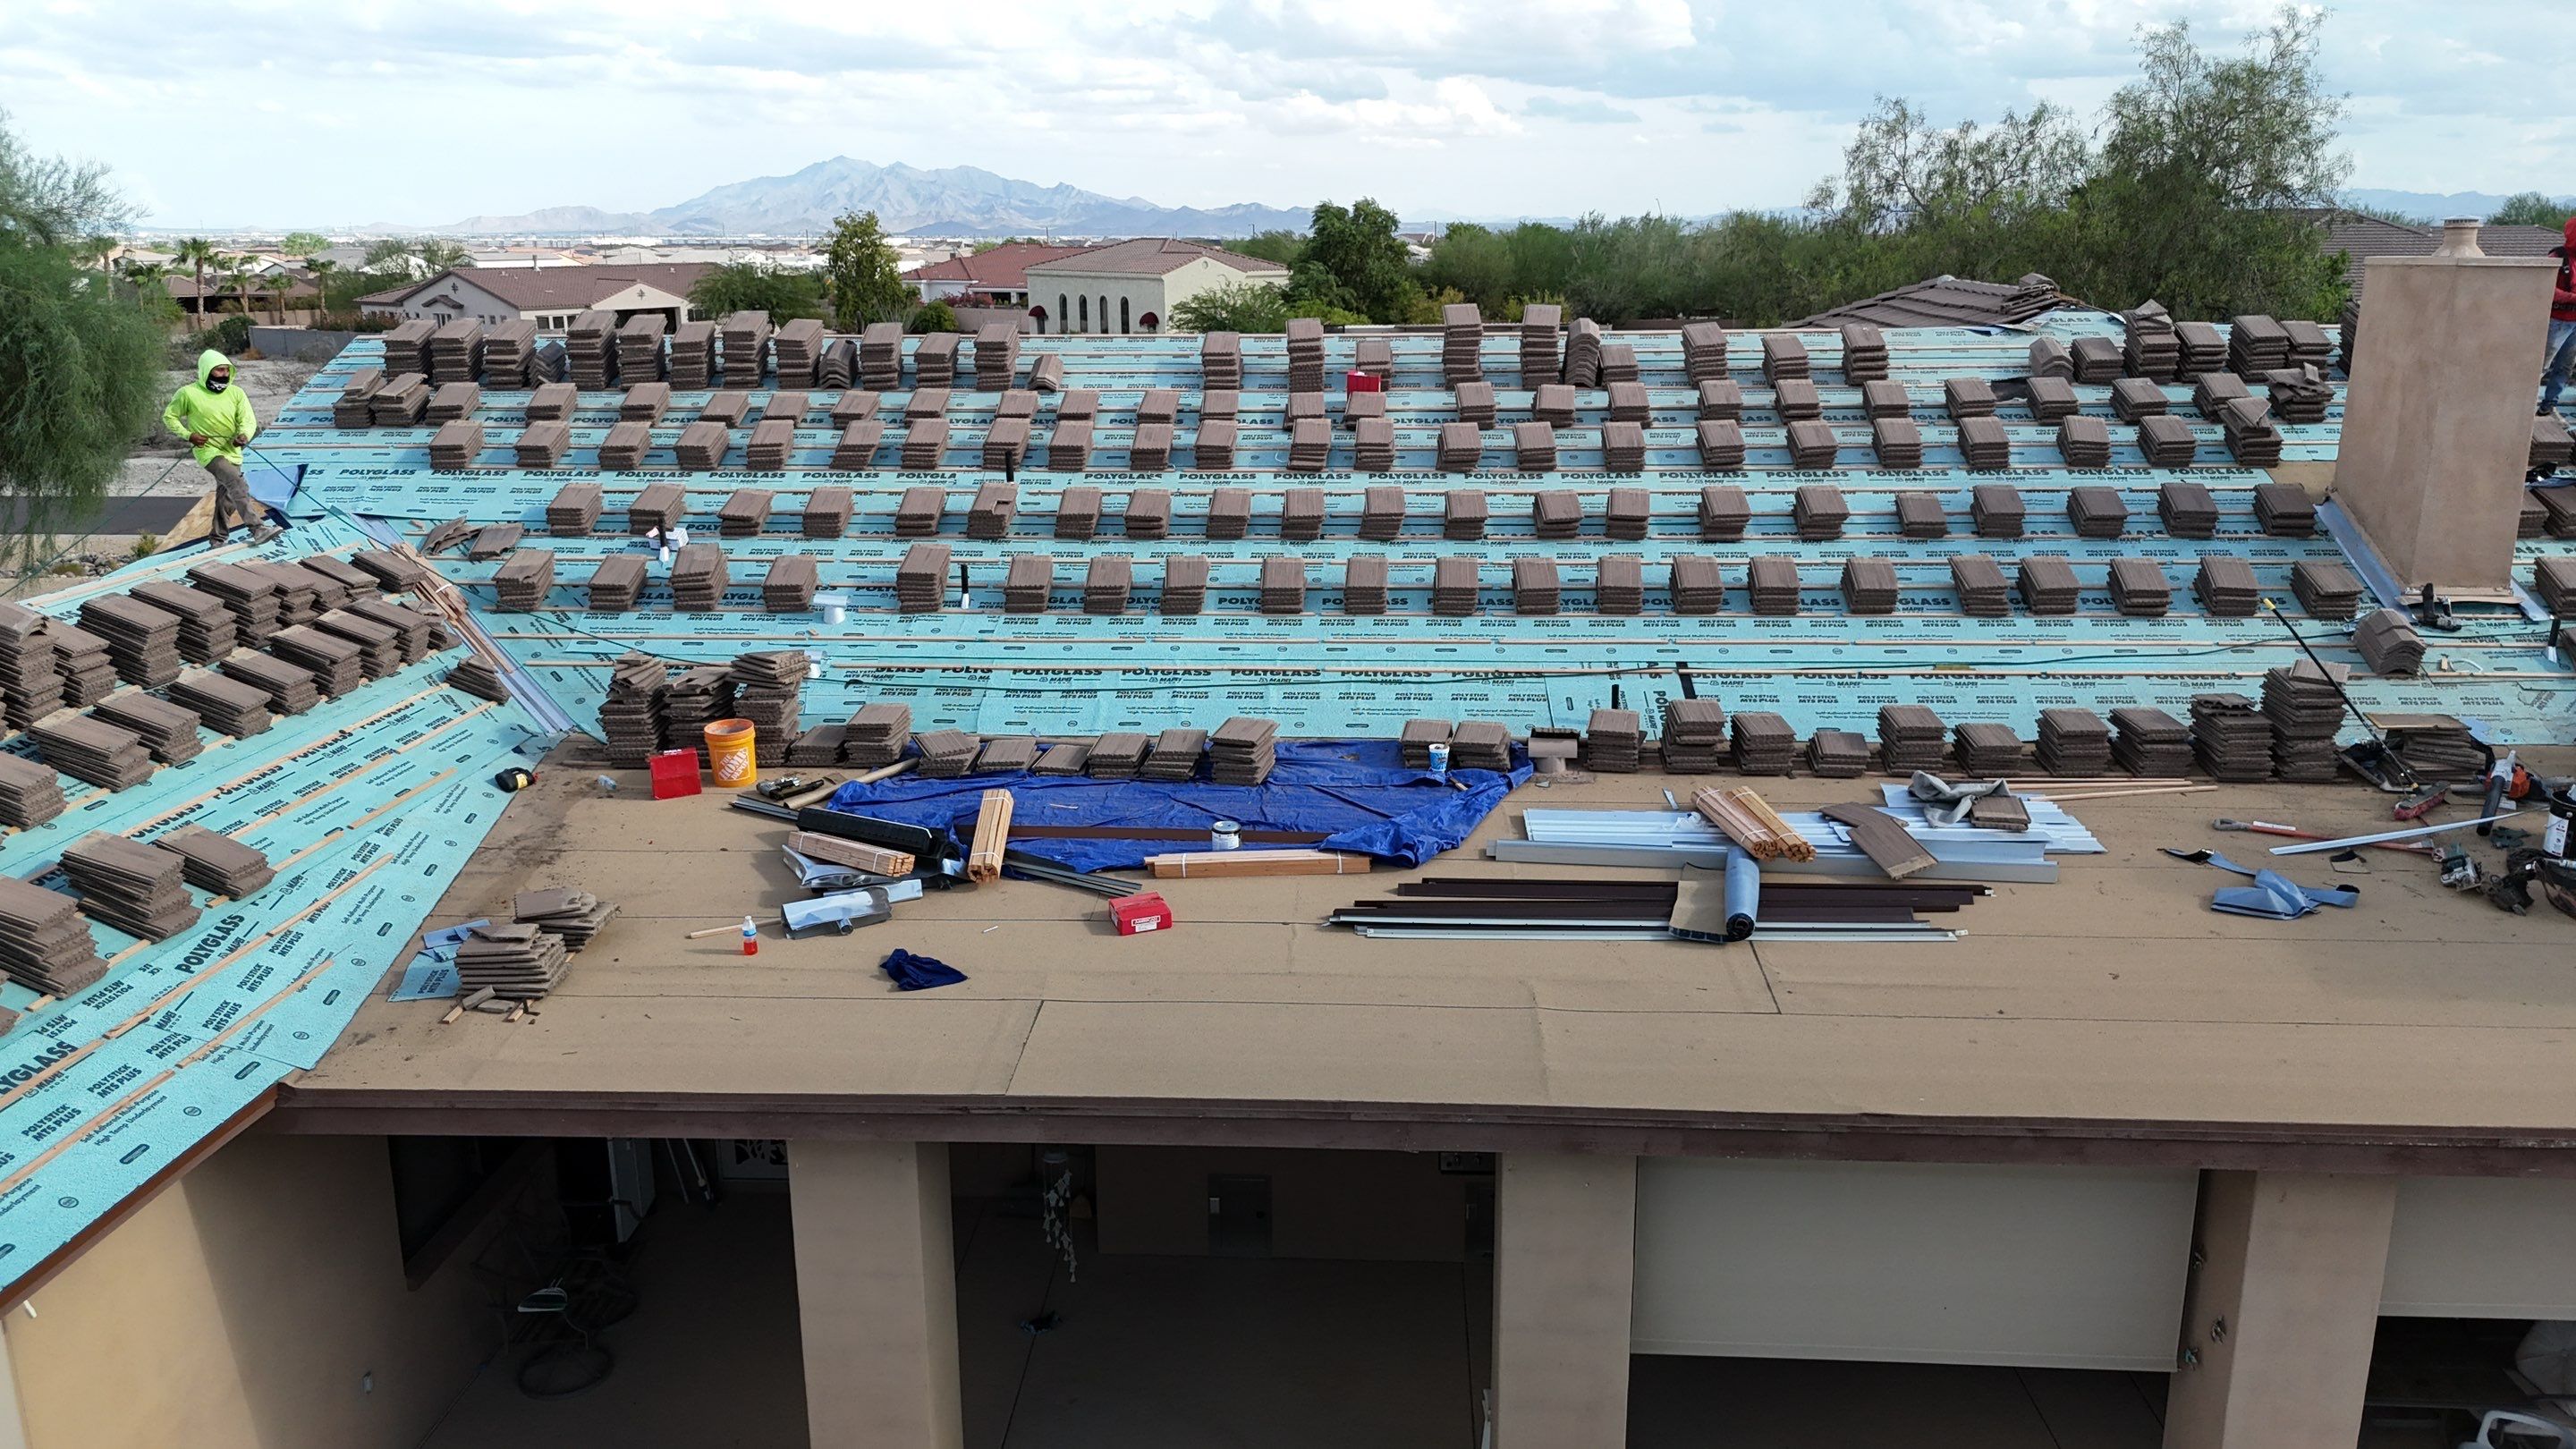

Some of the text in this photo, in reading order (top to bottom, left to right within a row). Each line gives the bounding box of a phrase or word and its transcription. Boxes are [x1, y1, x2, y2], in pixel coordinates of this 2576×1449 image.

[1767, 470, 1849, 479] POLYGLASS
[2067, 468, 2150, 476] POLYGLASS
[1230, 669, 1322, 677] POLYGLASS
[331, 744, 348, 756] MAPEI
[719, 748, 748, 780] HOME
[731, 759, 749, 780] DEPOT
[256, 780, 276, 792] MAPEI
[286, 874, 304, 889] MAPEI
[174, 913, 245, 975] POLYGLASS
[225, 936, 246, 954] MAPEI
[268, 929, 293, 953] POLYSTICK
[278, 931, 304, 957] MTS PLUS
[236, 962, 264, 989] POLYSTICK
[246, 966, 275, 993] MTS PLUS
[81, 979, 125, 1007] MTS PLUS
[92, 984, 134, 1011] POLYSTICK
[155, 1011, 177, 1030] MAPEI
[202, 1000, 231, 1029] POLYSTICK
[212, 1003, 242, 1032] MTS PLUS
[146, 1031, 182, 1055] POLYSTI
[156, 1034, 192, 1060] MTS PLU
[0, 1041, 79, 1095] LYGLASS
[36, 1071, 64, 1090] MAPEI
[87, 1063, 131, 1093] POLYSTICK
[97, 1067, 142, 1098] MTS PLUS
[21, 1103, 71, 1136] POLYSTICK
[32, 1107, 82, 1142] MTS PLUS
[94, 1135, 111, 1146] High
[109, 1123, 129, 1135] Temp
